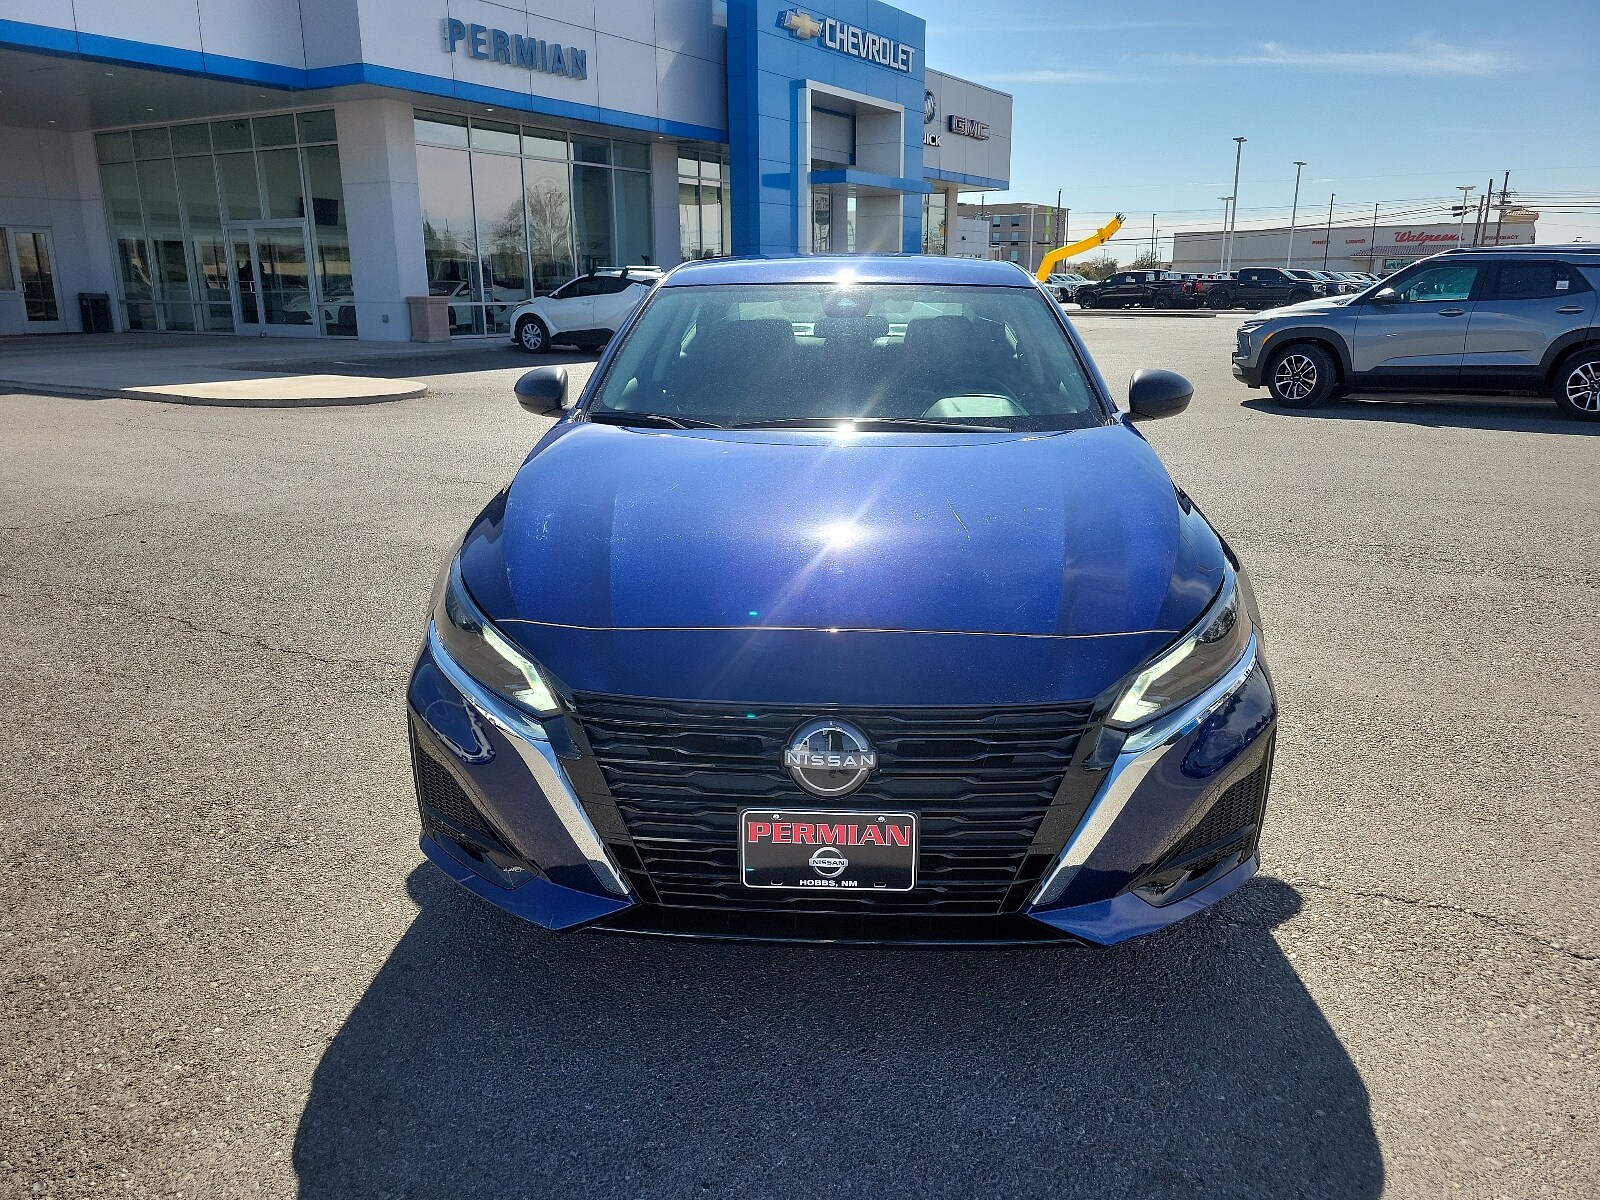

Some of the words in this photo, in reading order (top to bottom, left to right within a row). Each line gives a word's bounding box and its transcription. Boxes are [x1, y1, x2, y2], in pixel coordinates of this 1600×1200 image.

[442, 17, 588, 80] PERMIAN
[822, 17, 916, 73] CHEVROLET
[950, 115, 990, 140] GMC
[1394, 230, 1465, 246] Walgreens
[786, 751, 874, 767] NISSAN
[747, 821, 911, 847] PERMIAN
[799, 879, 839, 888] HOBBS,
